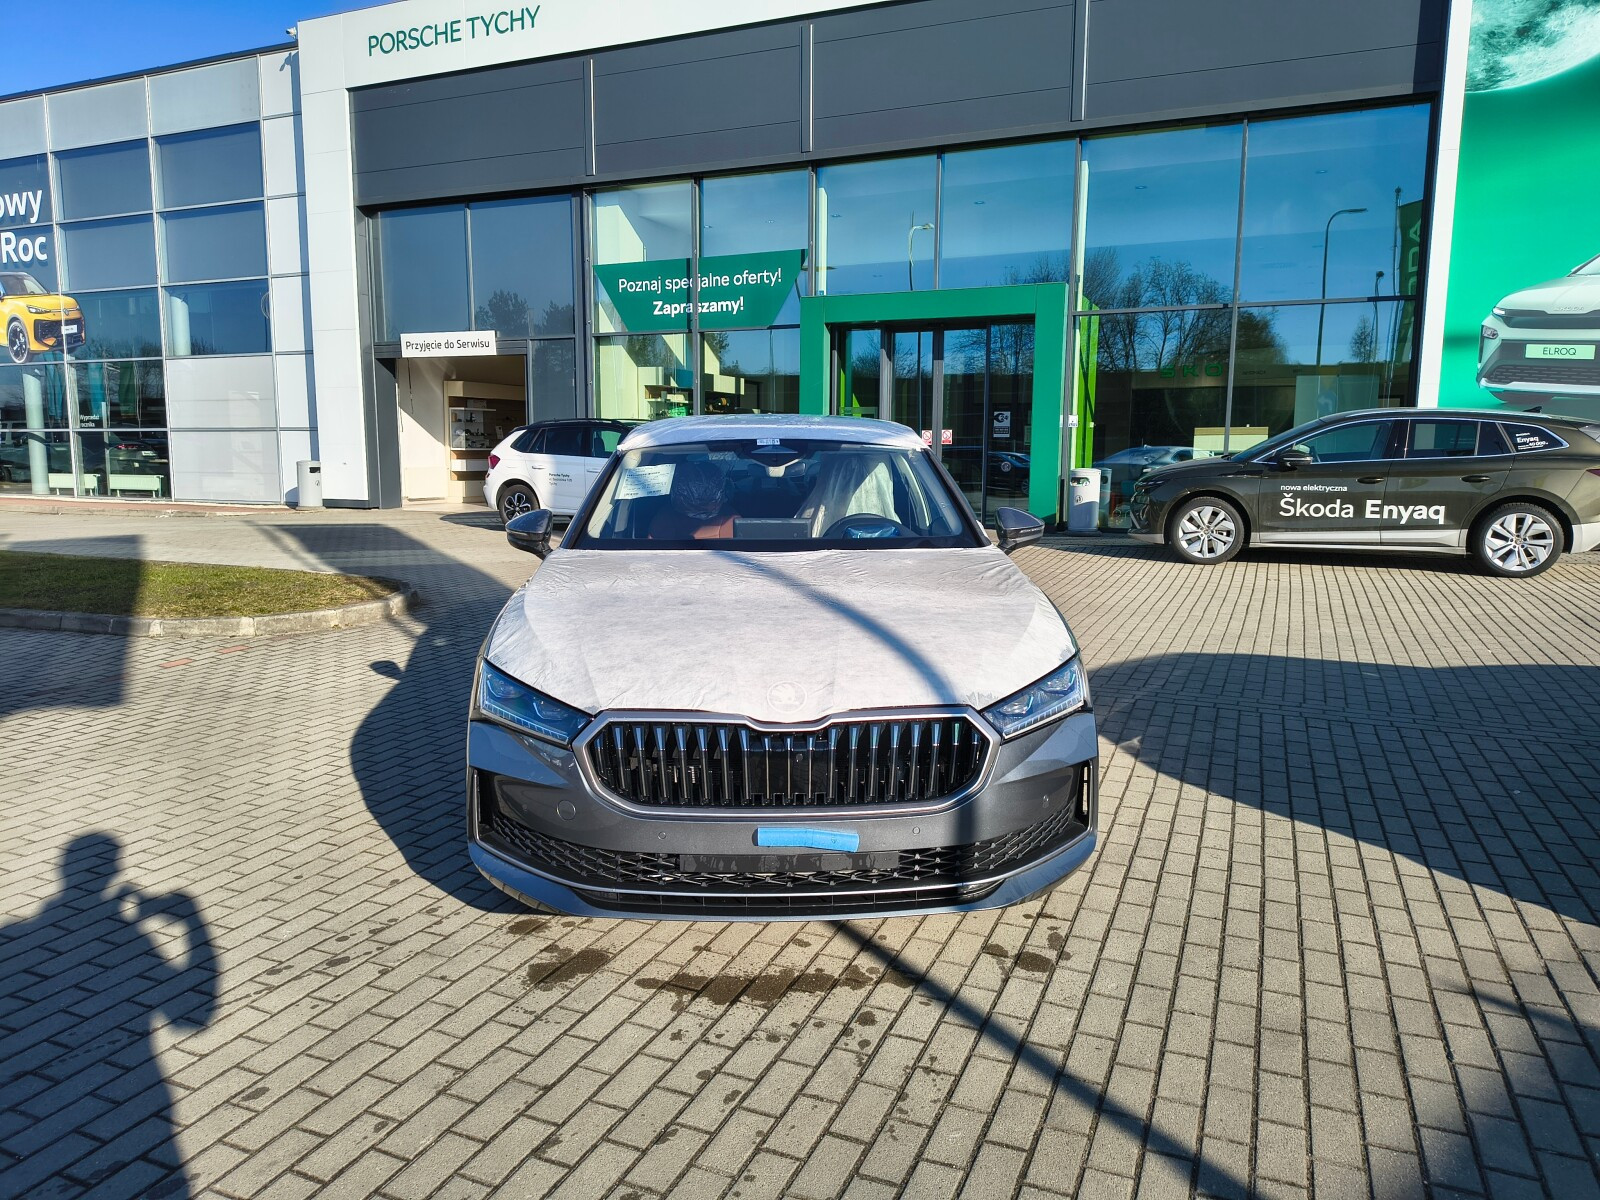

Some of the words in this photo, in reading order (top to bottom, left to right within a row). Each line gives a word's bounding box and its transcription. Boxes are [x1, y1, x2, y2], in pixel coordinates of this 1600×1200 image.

[368, 20, 462, 57] PORSCHE
[466, 5, 541, 39] TYCHY
[618, 276, 662, 294] Poznaj
[733, 267, 782, 287] oferty!
[652, 296, 744, 318] Zapraszamy!
[405, 340, 442, 352] Przyjęcie
[444, 339, 455, 349] do
[456, 338, 490, 349] Serwisu
[1542, 347, 1577, 356] ELROQ
[1303, 484, 1348, 492] elektryczna
[1279, 492, 1354, 518] Škoda
[1364, 499, 1446, 525] Enyaq
